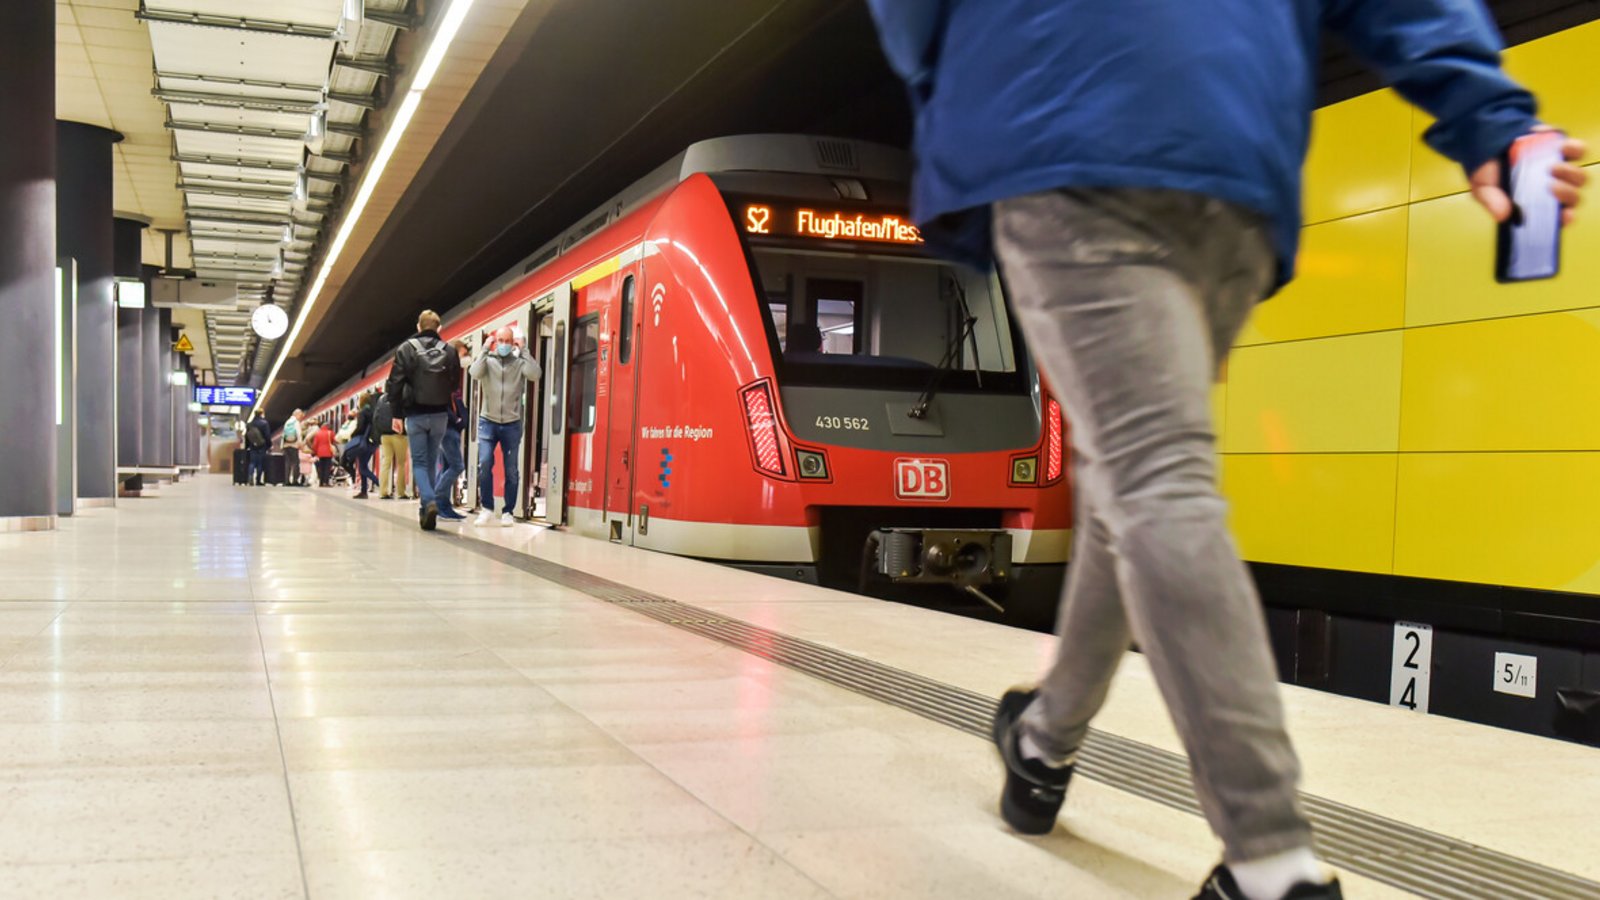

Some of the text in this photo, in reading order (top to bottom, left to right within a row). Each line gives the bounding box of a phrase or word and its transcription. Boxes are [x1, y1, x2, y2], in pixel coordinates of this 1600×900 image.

[746, 206, 770, 234] S2
[673, 425, 683, 439] die
[684, 424, 713, 442] Region
[815, 415, 870, 431] 430 562
[901, 463, 945, 494] DB
[1403, 630, 1421, 670] 2
[1503, 663, 1528, 686] 5/11
[1399, 676, 1417, 711] 4
